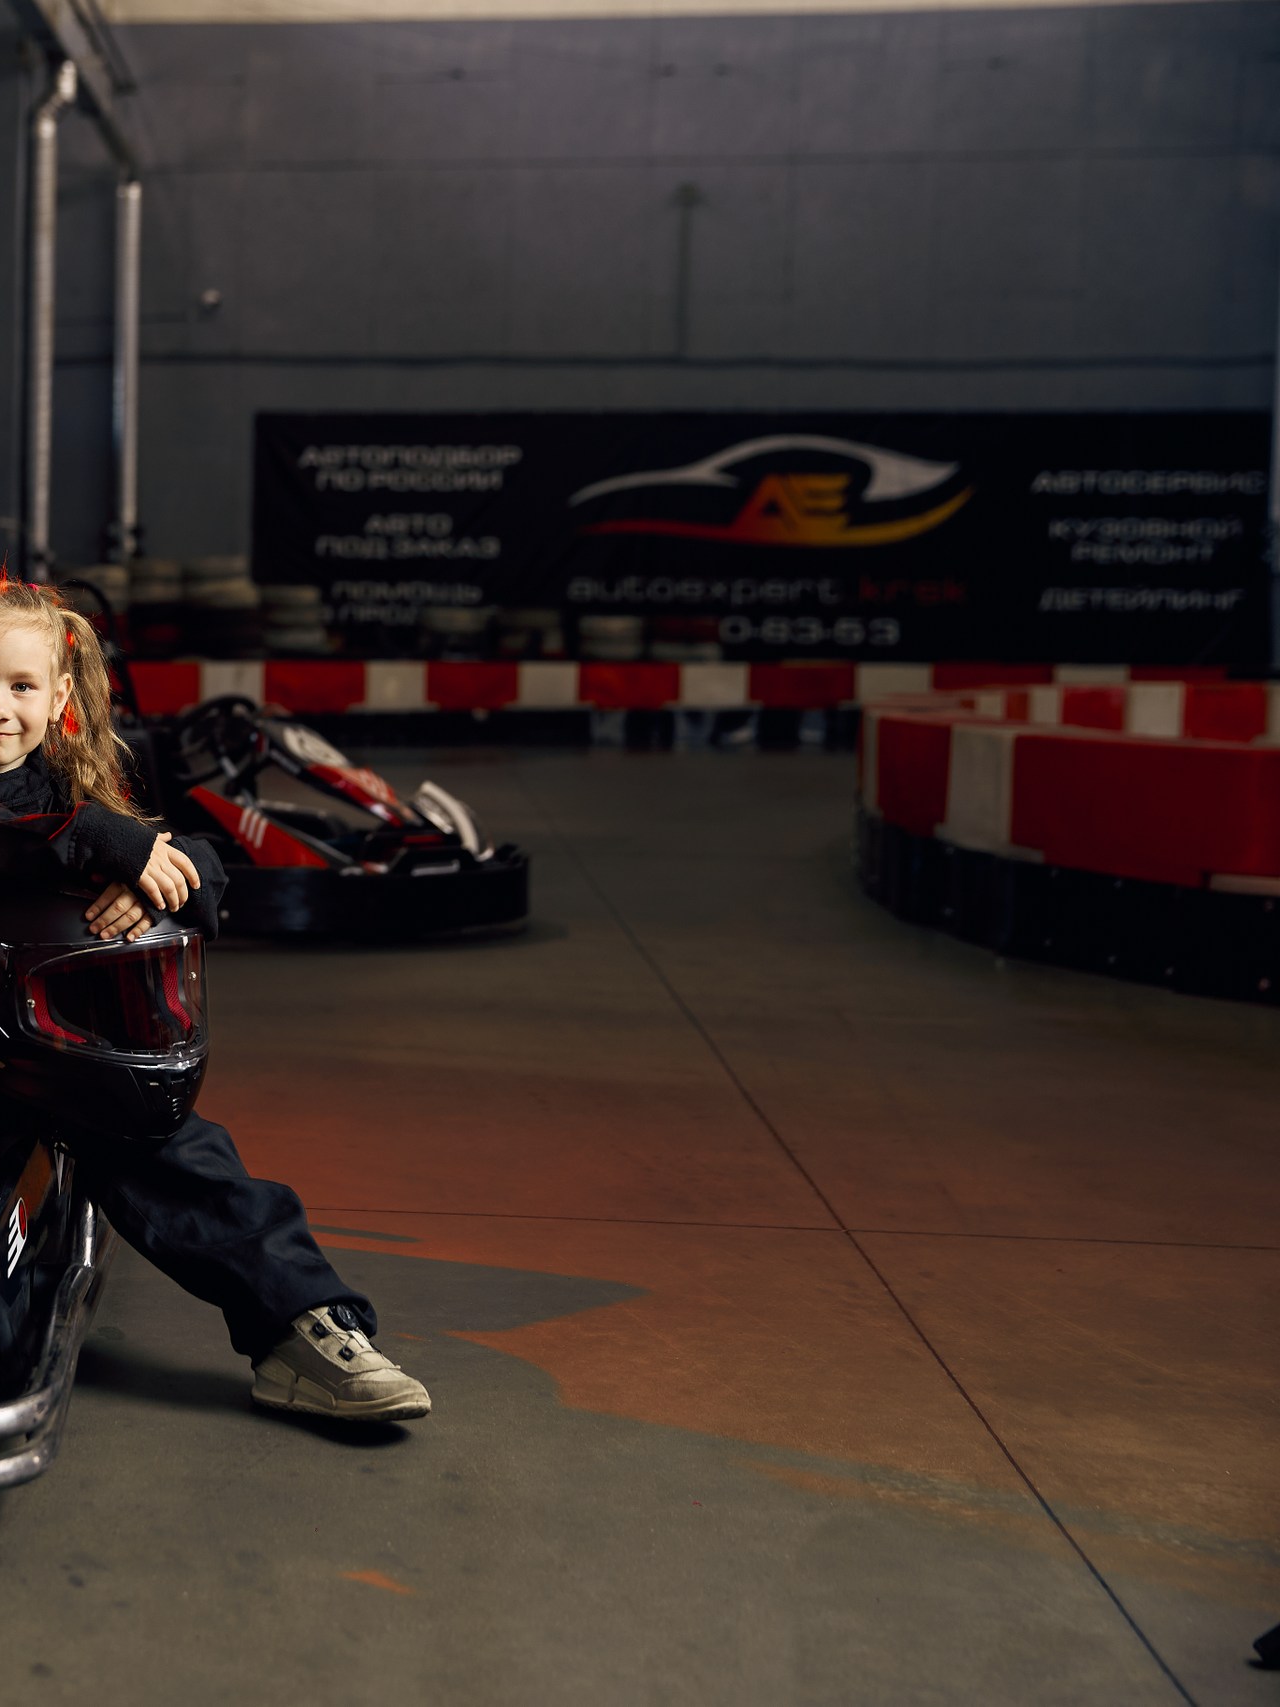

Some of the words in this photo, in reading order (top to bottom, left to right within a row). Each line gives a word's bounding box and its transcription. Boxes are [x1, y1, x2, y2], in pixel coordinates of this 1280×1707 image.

[298, 444, 523, 471] АВТОПОДБОР
[315, 467, 366, 493] ПО
[367, 467, 505, 493] РОССИИ
[1031, 468, 1266, 496] АВТОСЕРВИС
[364, 512, 455, 539] АВТО
[1048, 515, 1243, 543] КУЗОВНОЙ
[315, 534, 389, 560] ПОД
[391, 535, 502, 560] ЗАКАЗ
[1071, 541, 1216, 566] РЕМОНТ
[566, 575, 842, 607] autoexpert
[1036, 585, 1246, 613] ДЕТЕЙЛИНГ
